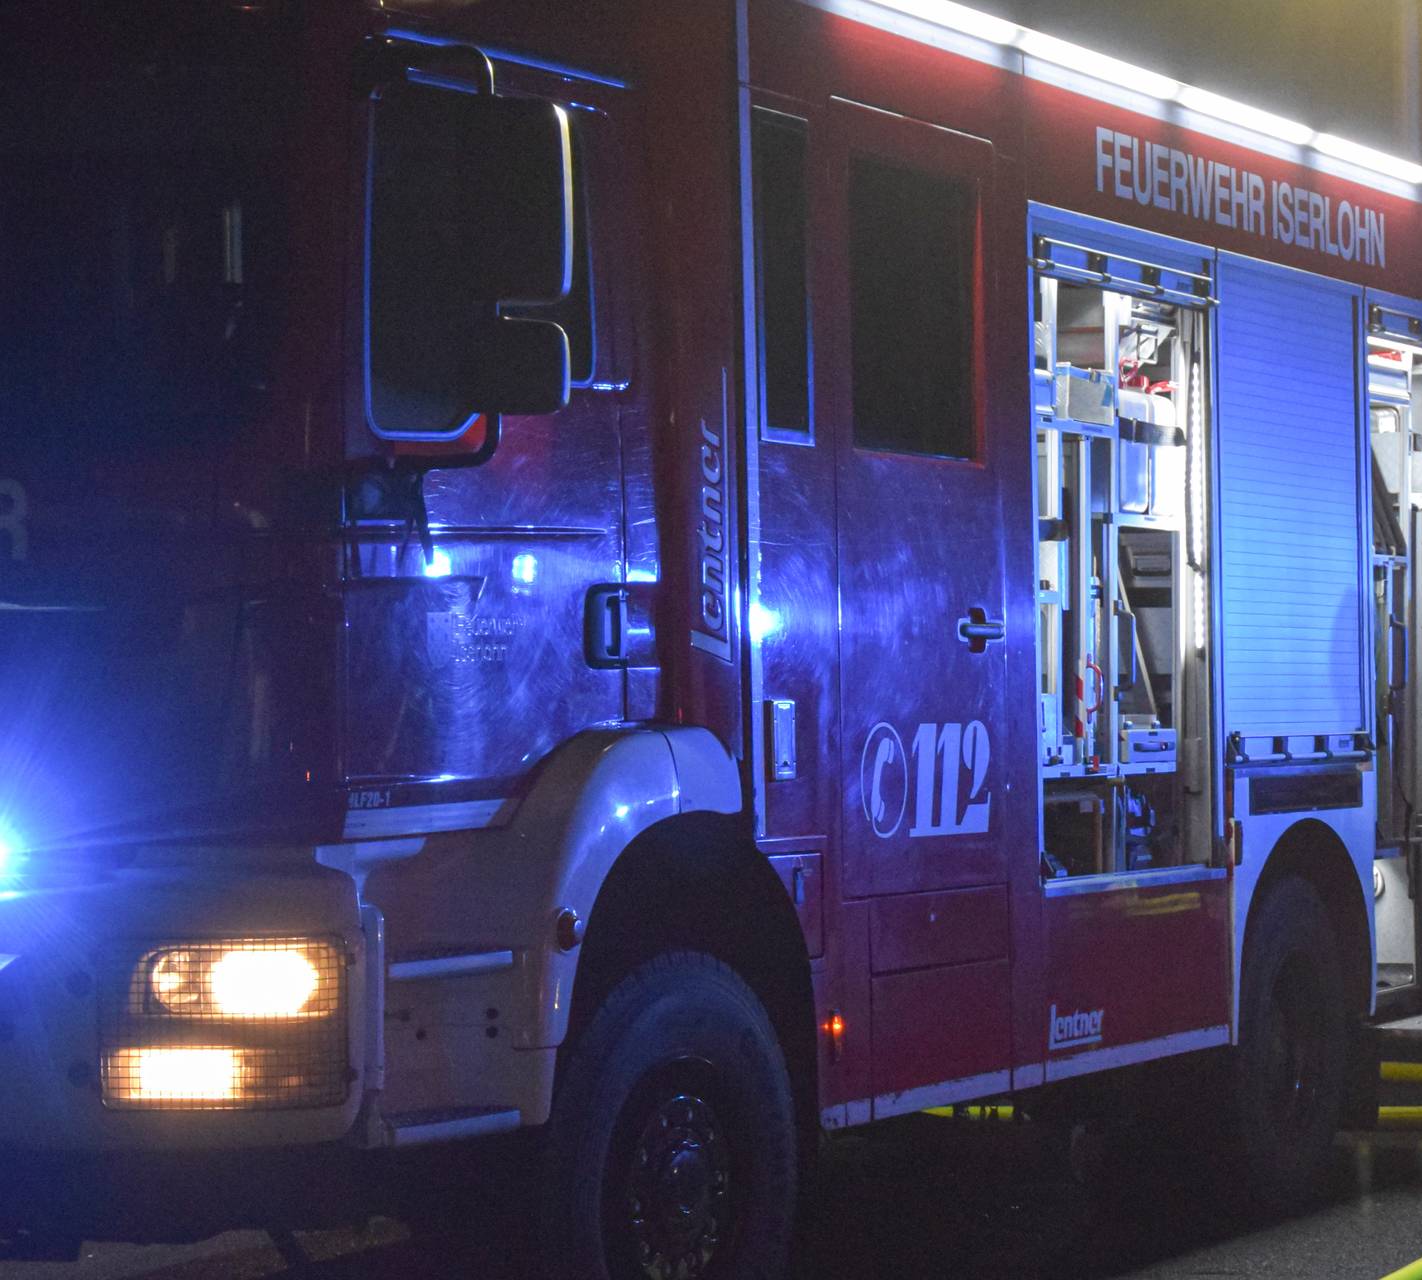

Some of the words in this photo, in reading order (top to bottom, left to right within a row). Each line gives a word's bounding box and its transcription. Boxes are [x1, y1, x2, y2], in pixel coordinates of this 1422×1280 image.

[1096, 126, 1265, 236] FEUERWEHR
[1272, 180, 1386, 269] ISERLOHN
[910, 720, 992, 838] 112
